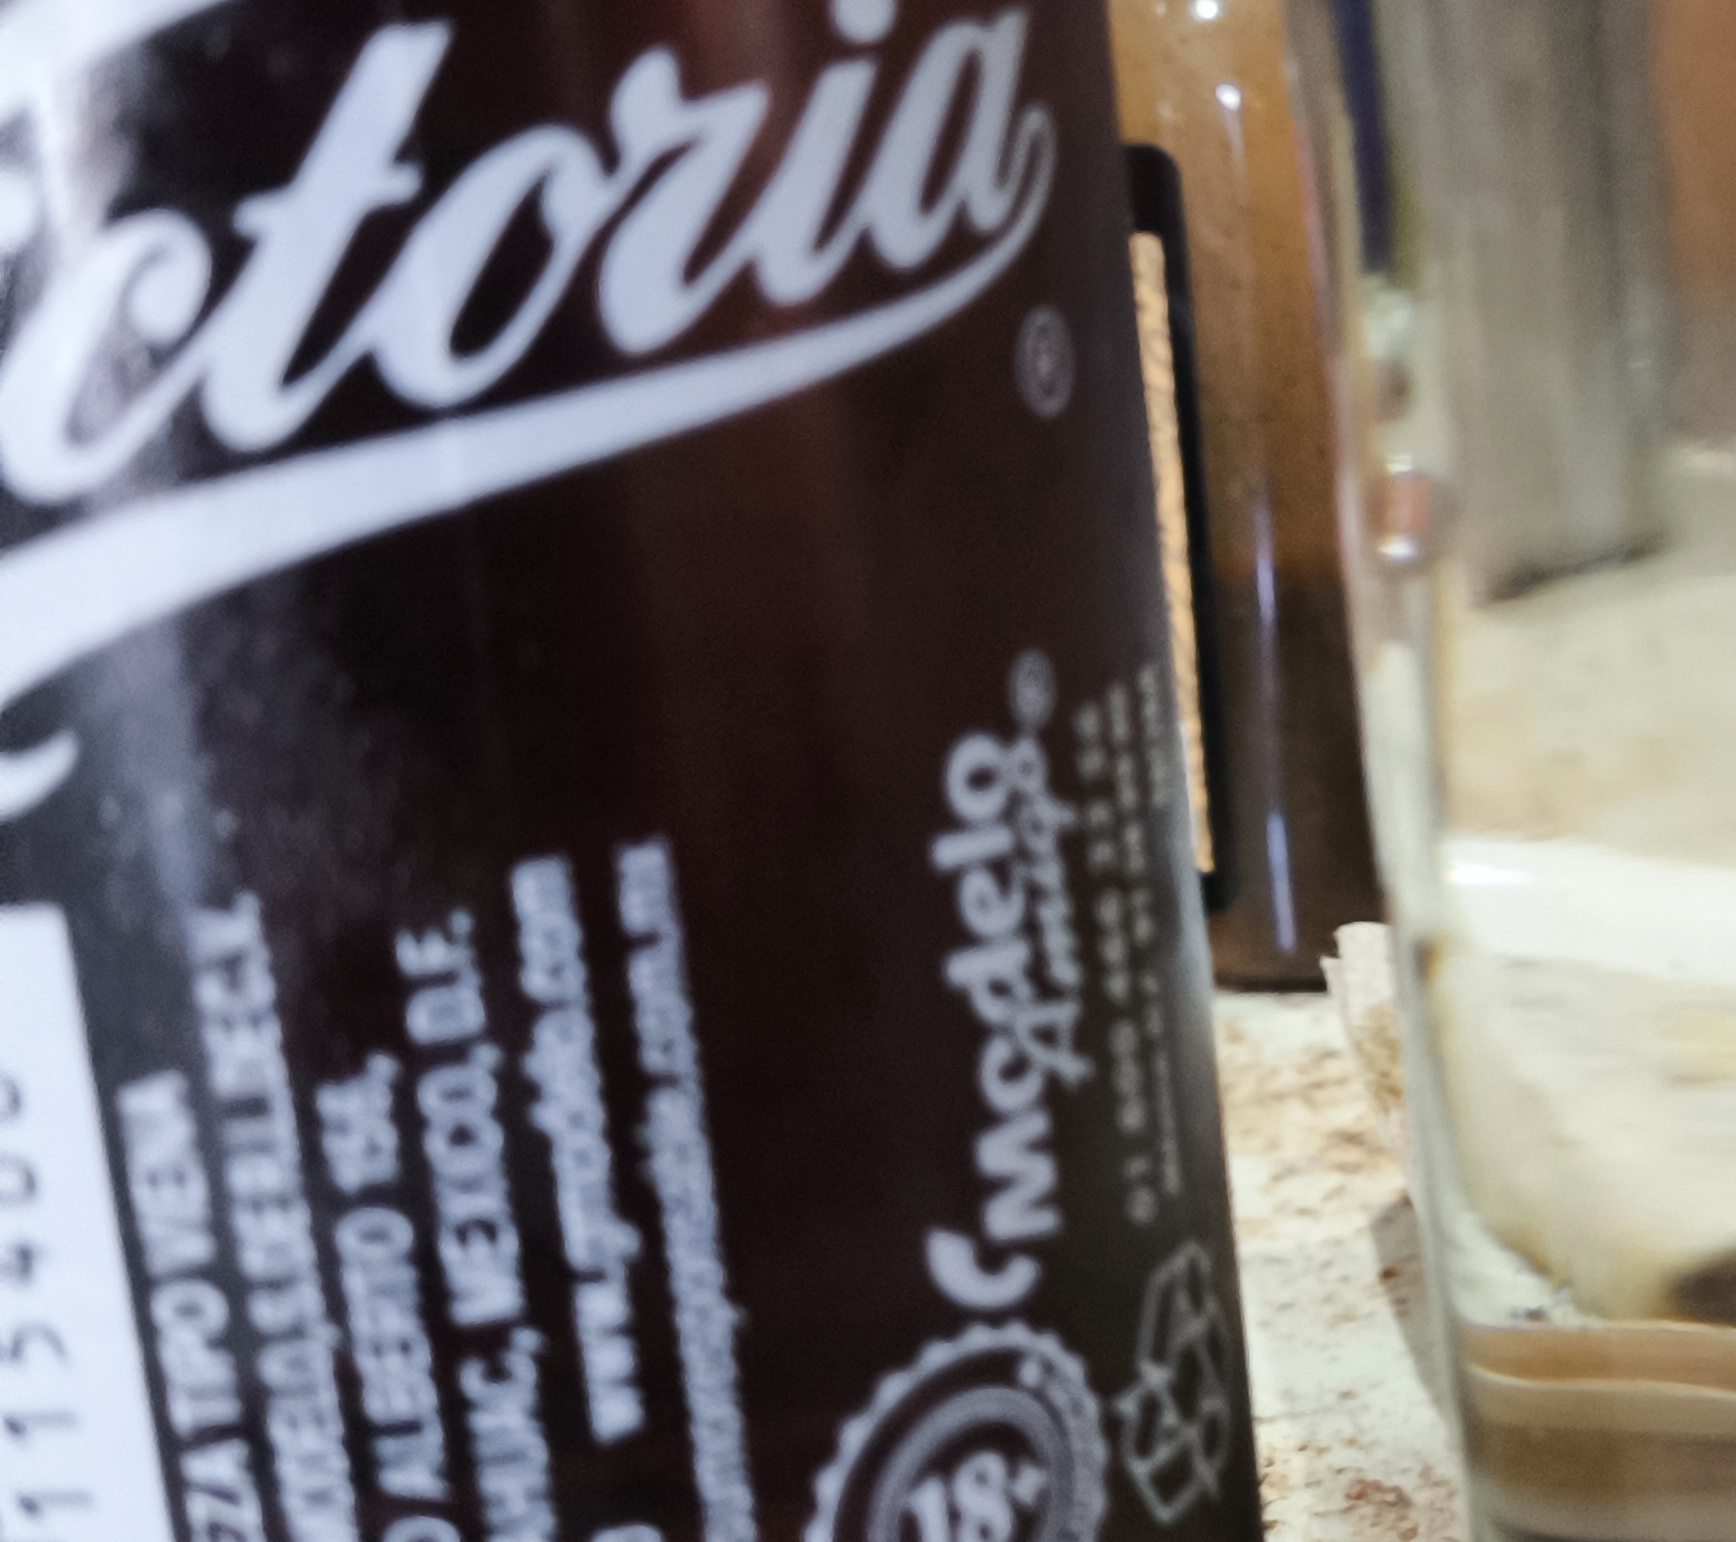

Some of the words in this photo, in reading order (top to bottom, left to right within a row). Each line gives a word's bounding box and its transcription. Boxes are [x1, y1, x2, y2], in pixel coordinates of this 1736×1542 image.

[394, 905, 488, 1049] D.F.
[930, 731, 1062, 1242] Modelo
[0, 1071, 93, 1519] 1154
[150, 1277, 242, 1439] TIPO
[335, 1205, 450, 1501] ALBERTO
